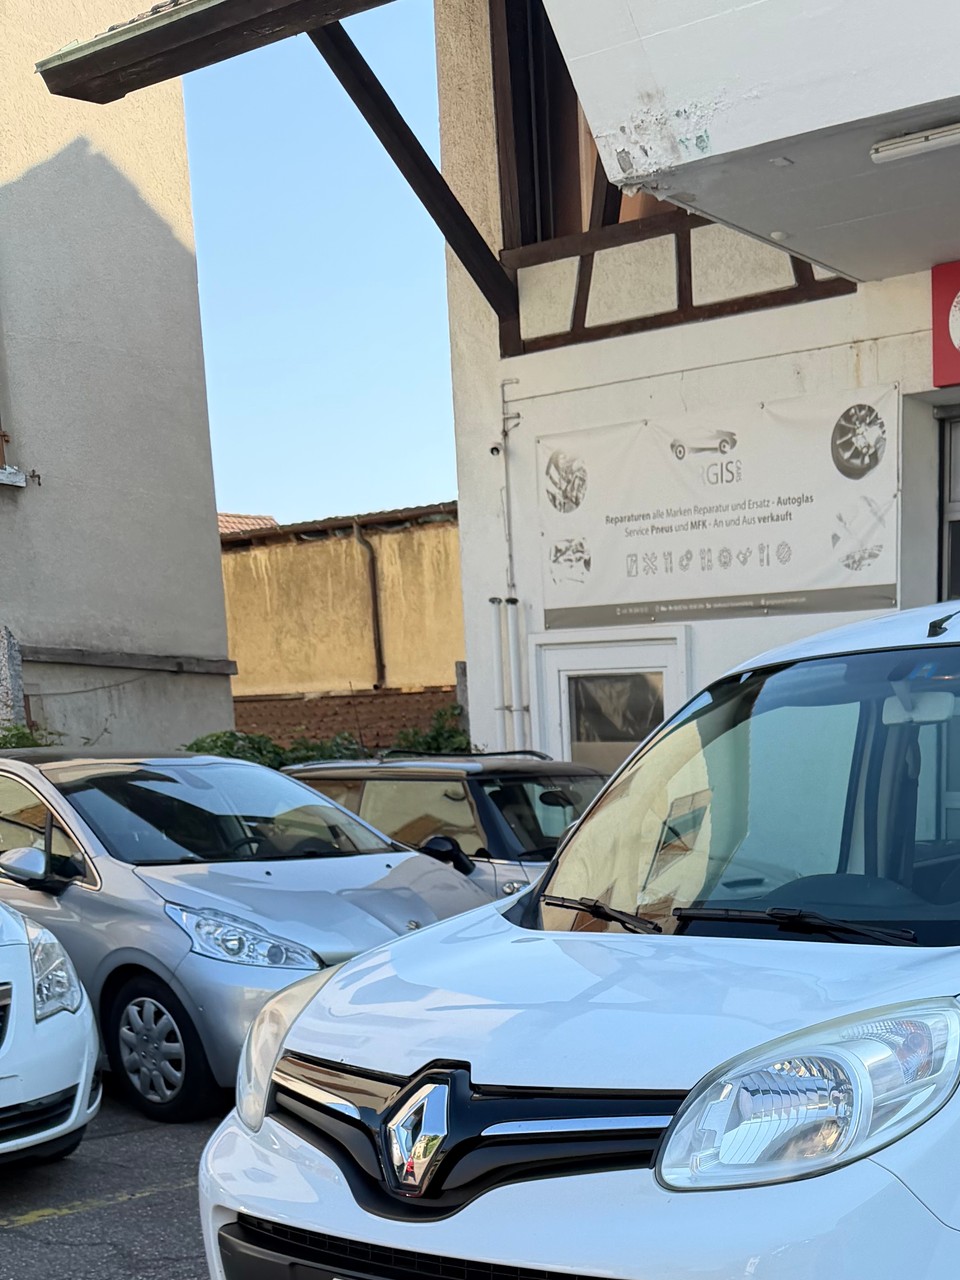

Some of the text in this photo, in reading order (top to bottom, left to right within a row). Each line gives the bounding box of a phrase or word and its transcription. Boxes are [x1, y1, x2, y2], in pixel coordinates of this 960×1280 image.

[605, 513, 651, 526] Reparaturen
[652, 509, 665, 519] alle
[666, 506, 692, 518] Marken
[693, 503, 730, 516] Reparatur
[731, 501, 747, 511] und
[748, 498, 771, 510] Ersatz
[776, 493, 814, 507] Autoglas
[624, 526, 650, 538] Service
[650, 524, 674, 536] Pneus
[674, 521, 689, 532] und
[690, 519, 708, 531] MFK
[713, 518, 724, 528] An
[725, 516, 741, 527] und
[741, 515, 756, 526] Aus
[757, 510, 792, 524] verkauft
